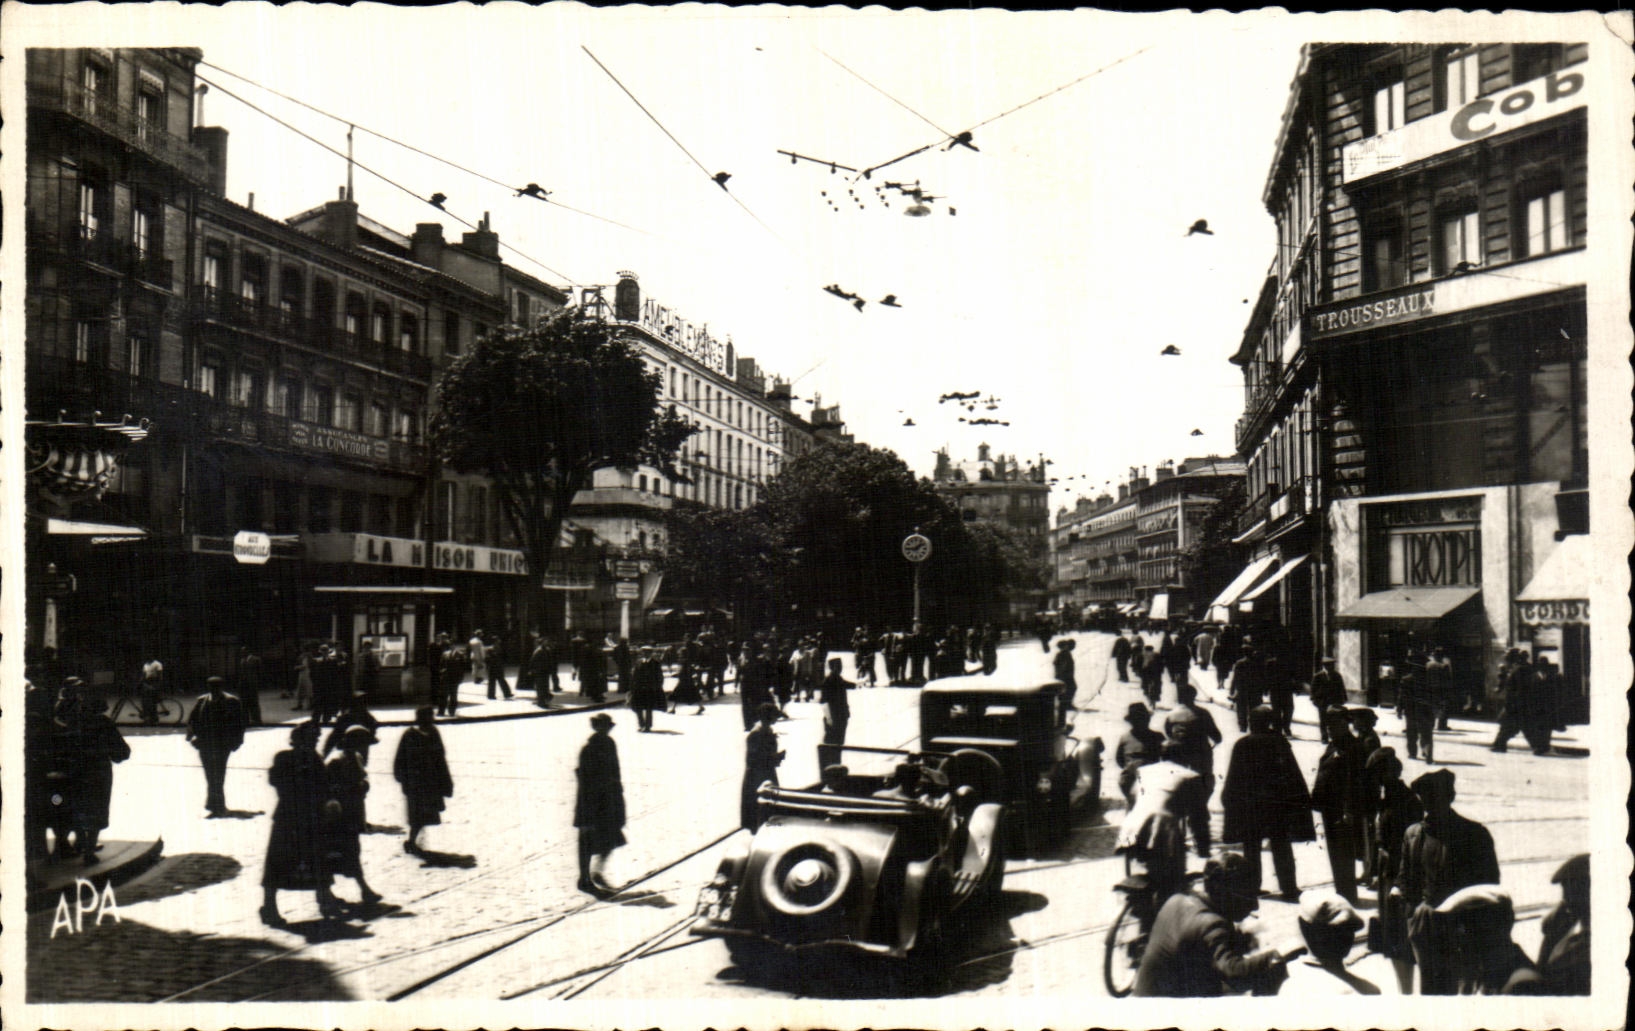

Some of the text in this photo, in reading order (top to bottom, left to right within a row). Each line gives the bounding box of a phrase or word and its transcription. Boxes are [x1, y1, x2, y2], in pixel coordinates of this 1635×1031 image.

[1450, 72, 1585, 141] Cob
[1316, 290, 1433, 332] TROUSSEAUX
[312, 434, 324, 448] LA
[326, 436, 372, 457] CONCORDE
[367, 538, 393, 564] LA
[411, 544, 475, 570] MISON
